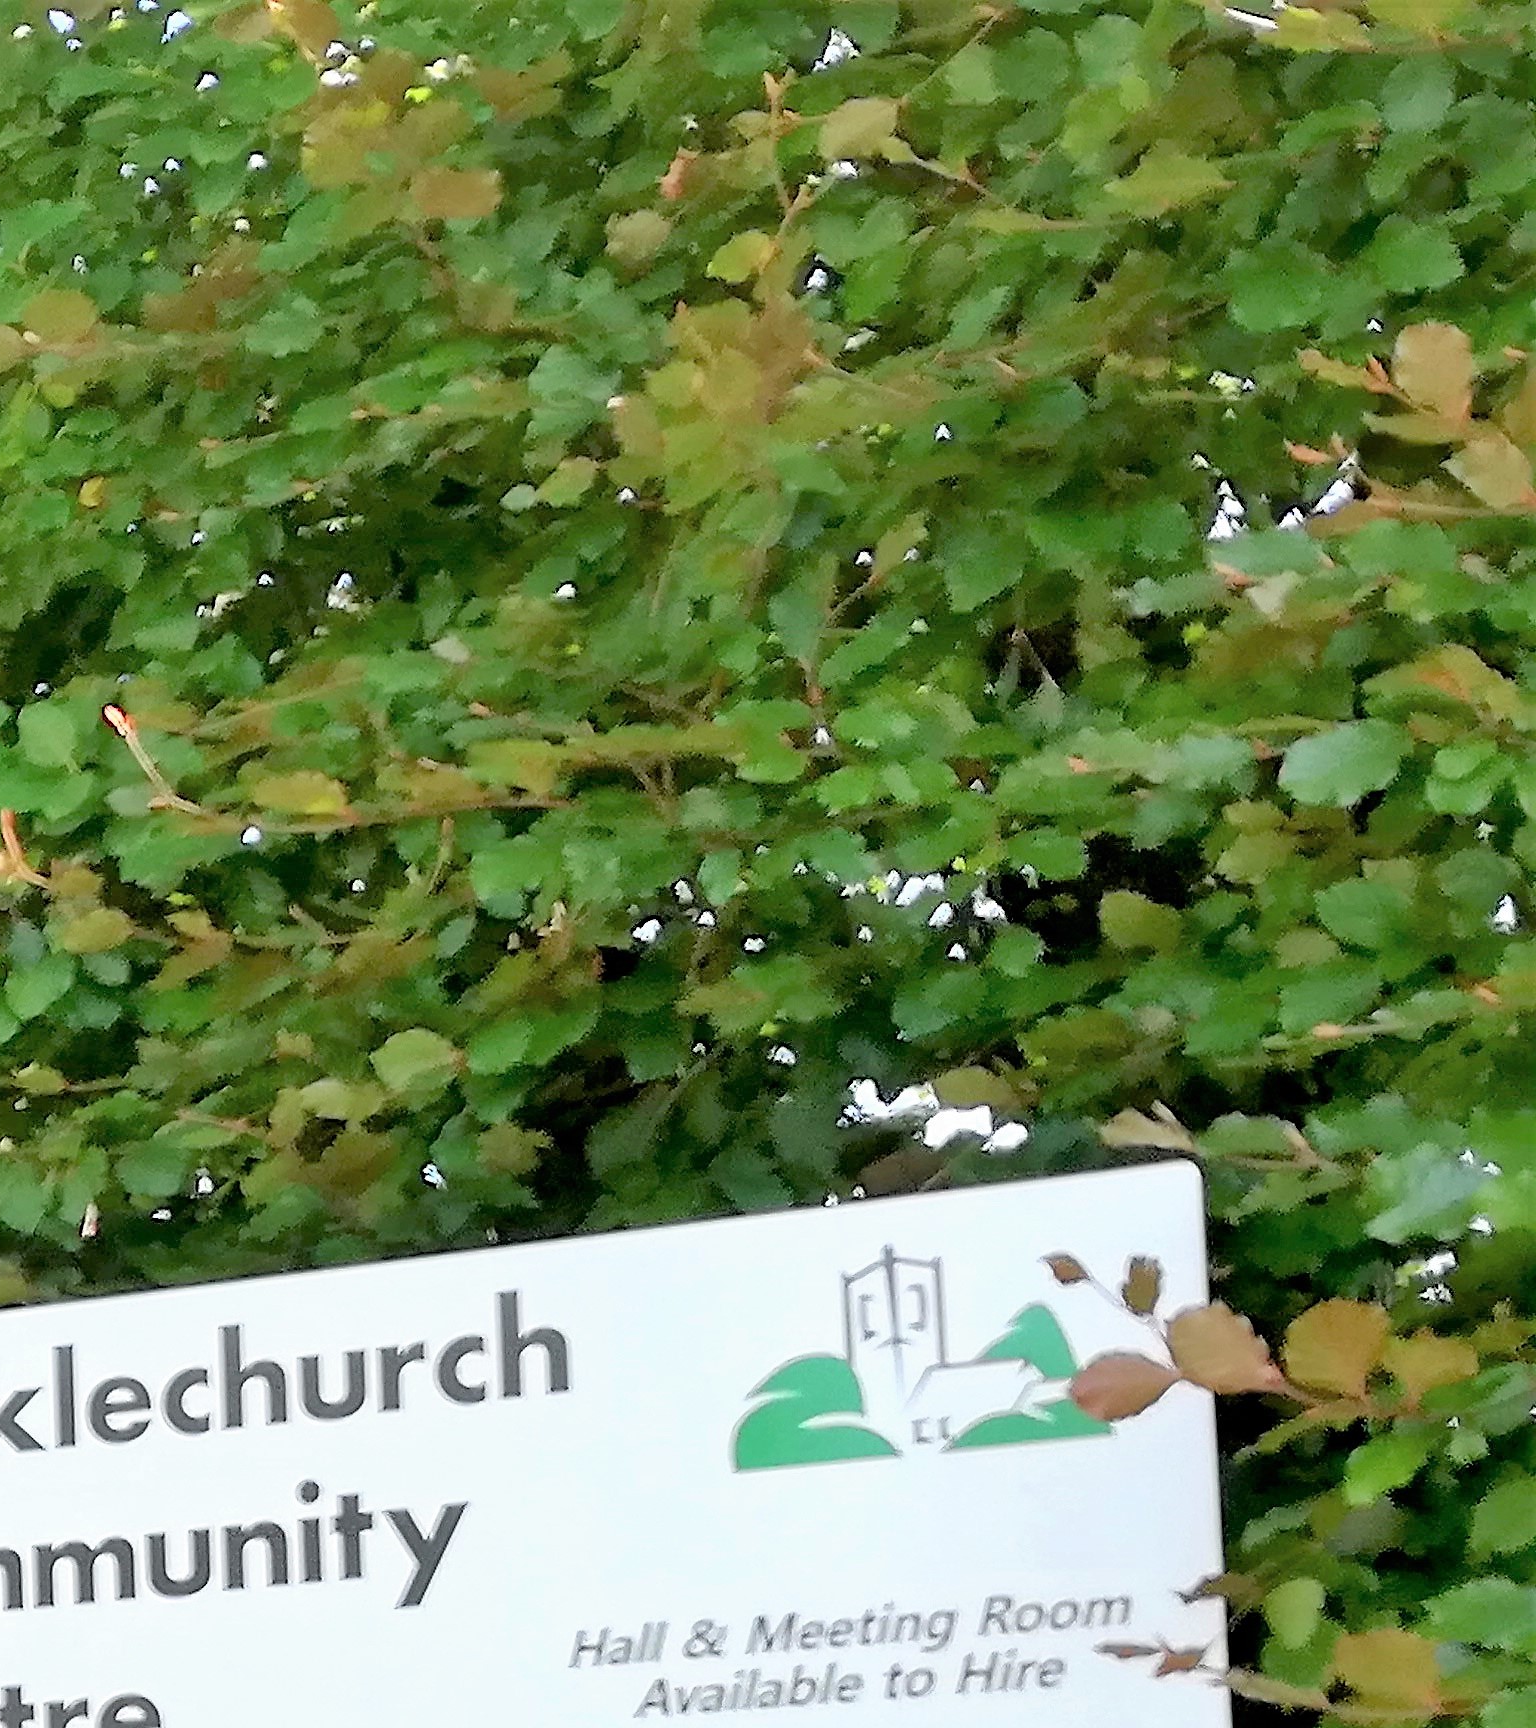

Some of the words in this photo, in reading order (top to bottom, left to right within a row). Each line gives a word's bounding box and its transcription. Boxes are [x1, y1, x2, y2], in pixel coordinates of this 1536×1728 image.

[566, 1619, 671, 1670] Hall
[680, 1617, 730, 1661] &
[743, 1600, 961, 1658] Meeting
[976, 1593, 1135, 1639] Room
[631, 1660, 866, 1720] Available
[881, 1661, 939, 1702] to
[953, 1646, 1069, 1697] Hire
